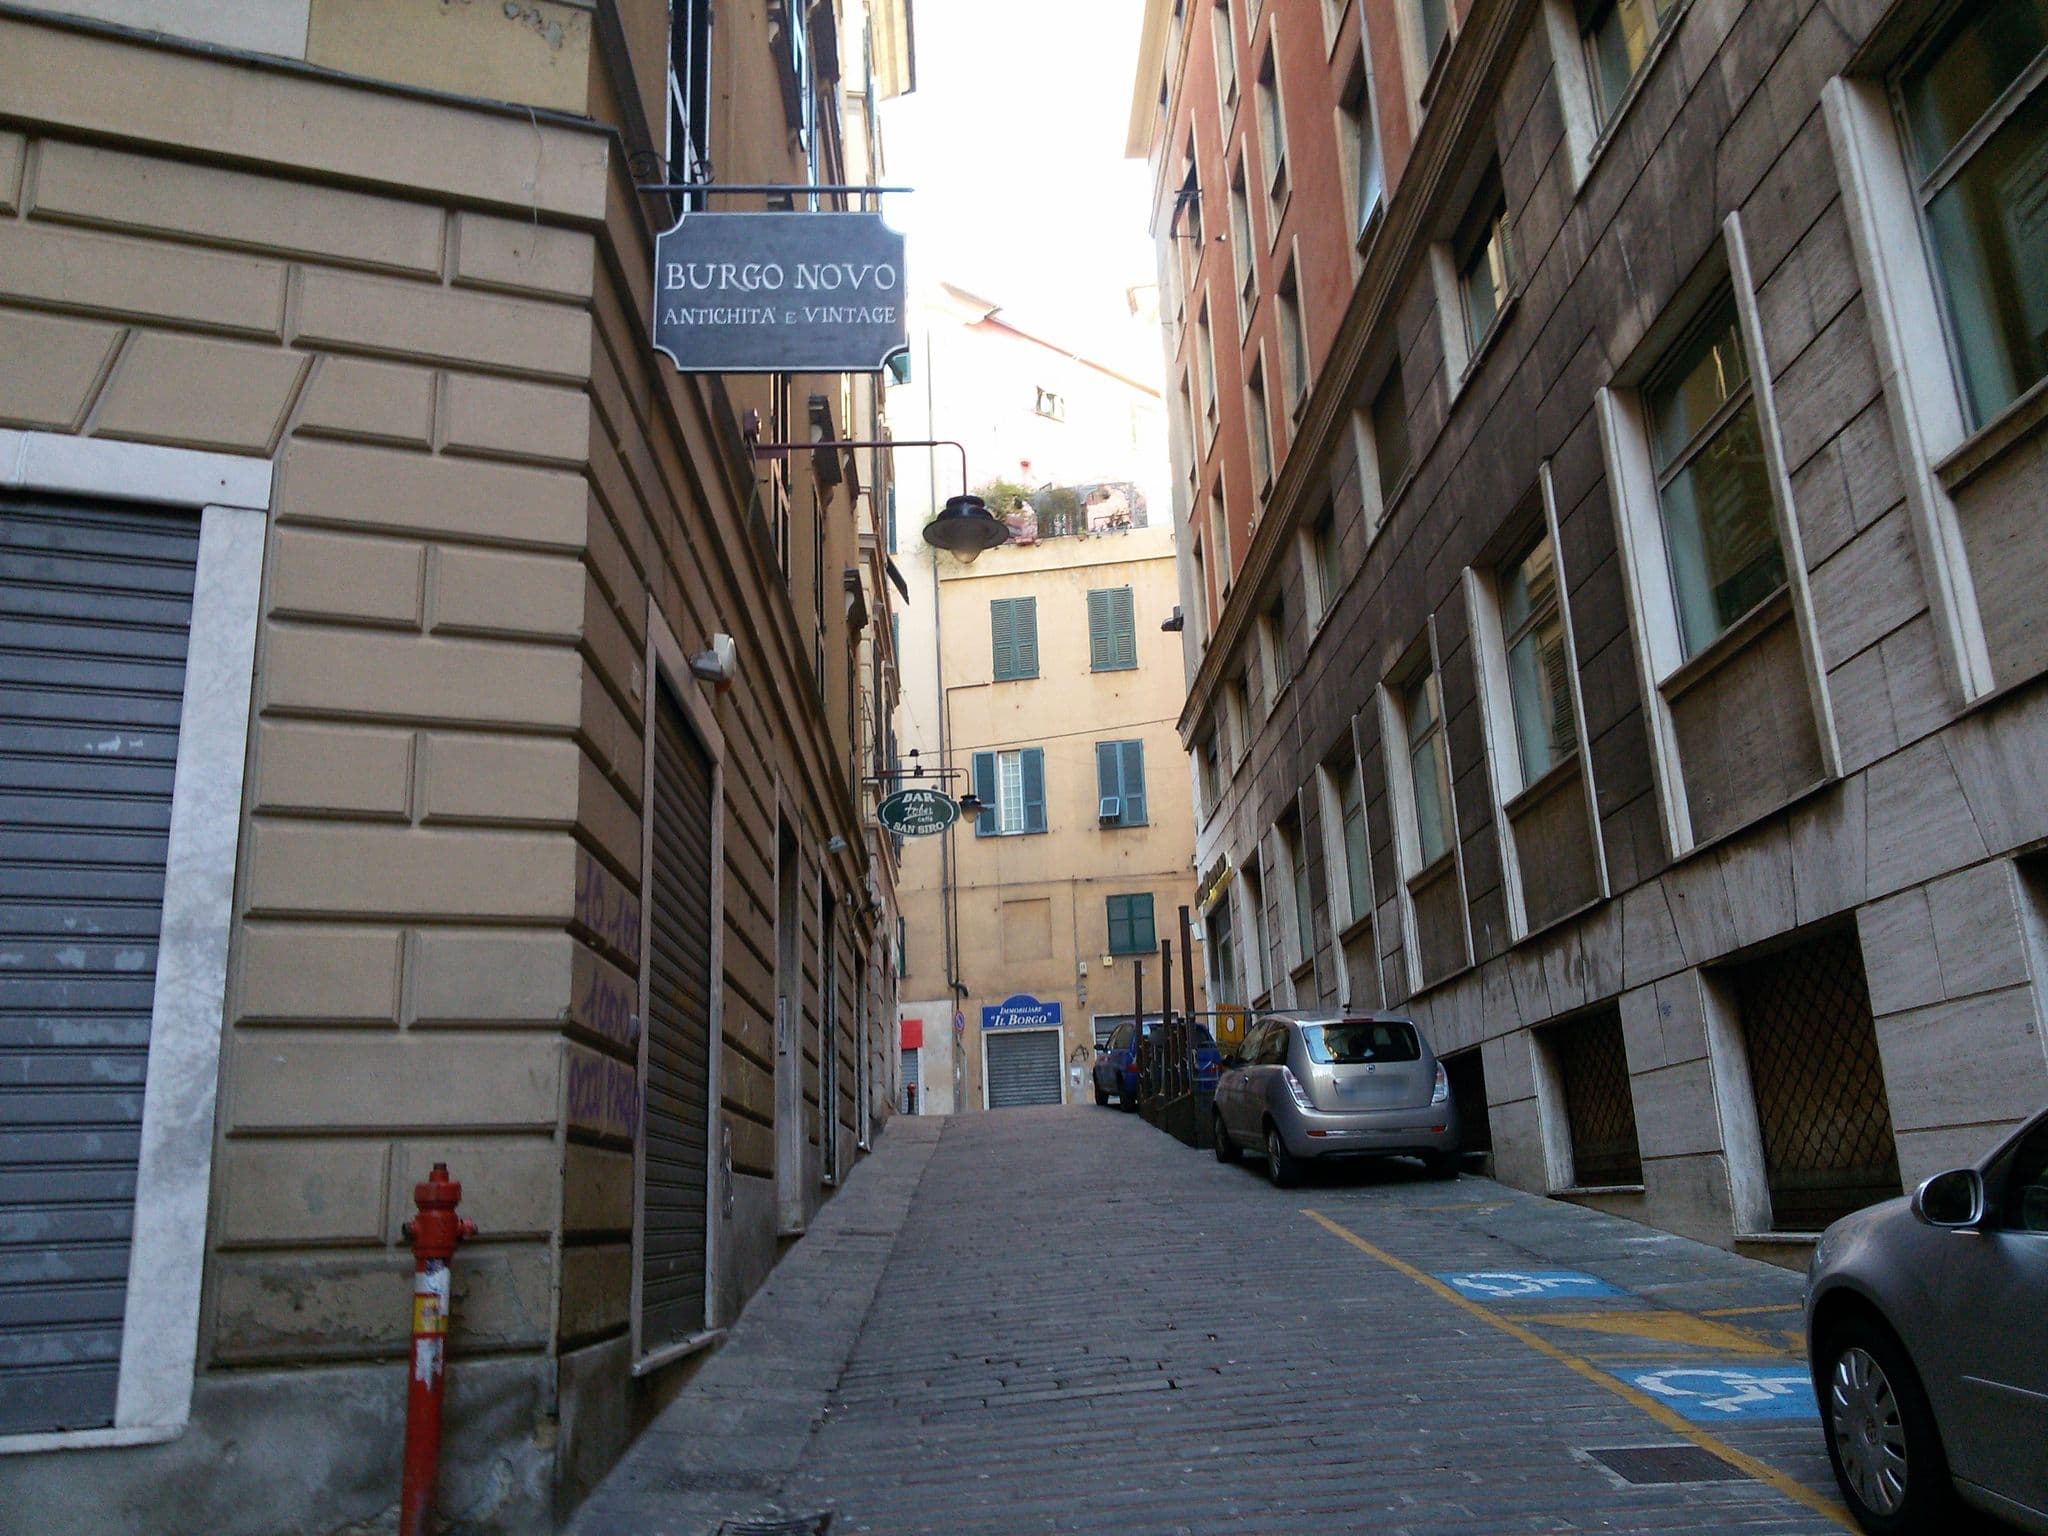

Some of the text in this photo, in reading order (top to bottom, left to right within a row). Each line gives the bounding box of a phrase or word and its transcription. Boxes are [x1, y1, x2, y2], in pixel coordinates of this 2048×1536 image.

[664, 263, 896, 292] BURGO NOVO
[803, 306, 896, 324] VINTAGE
[902, 792, 935, 803] BAR
[893, 822, 945, 834] SAN SIRO
[999, 1006, 1042, 1015] IMMOBILIARE
